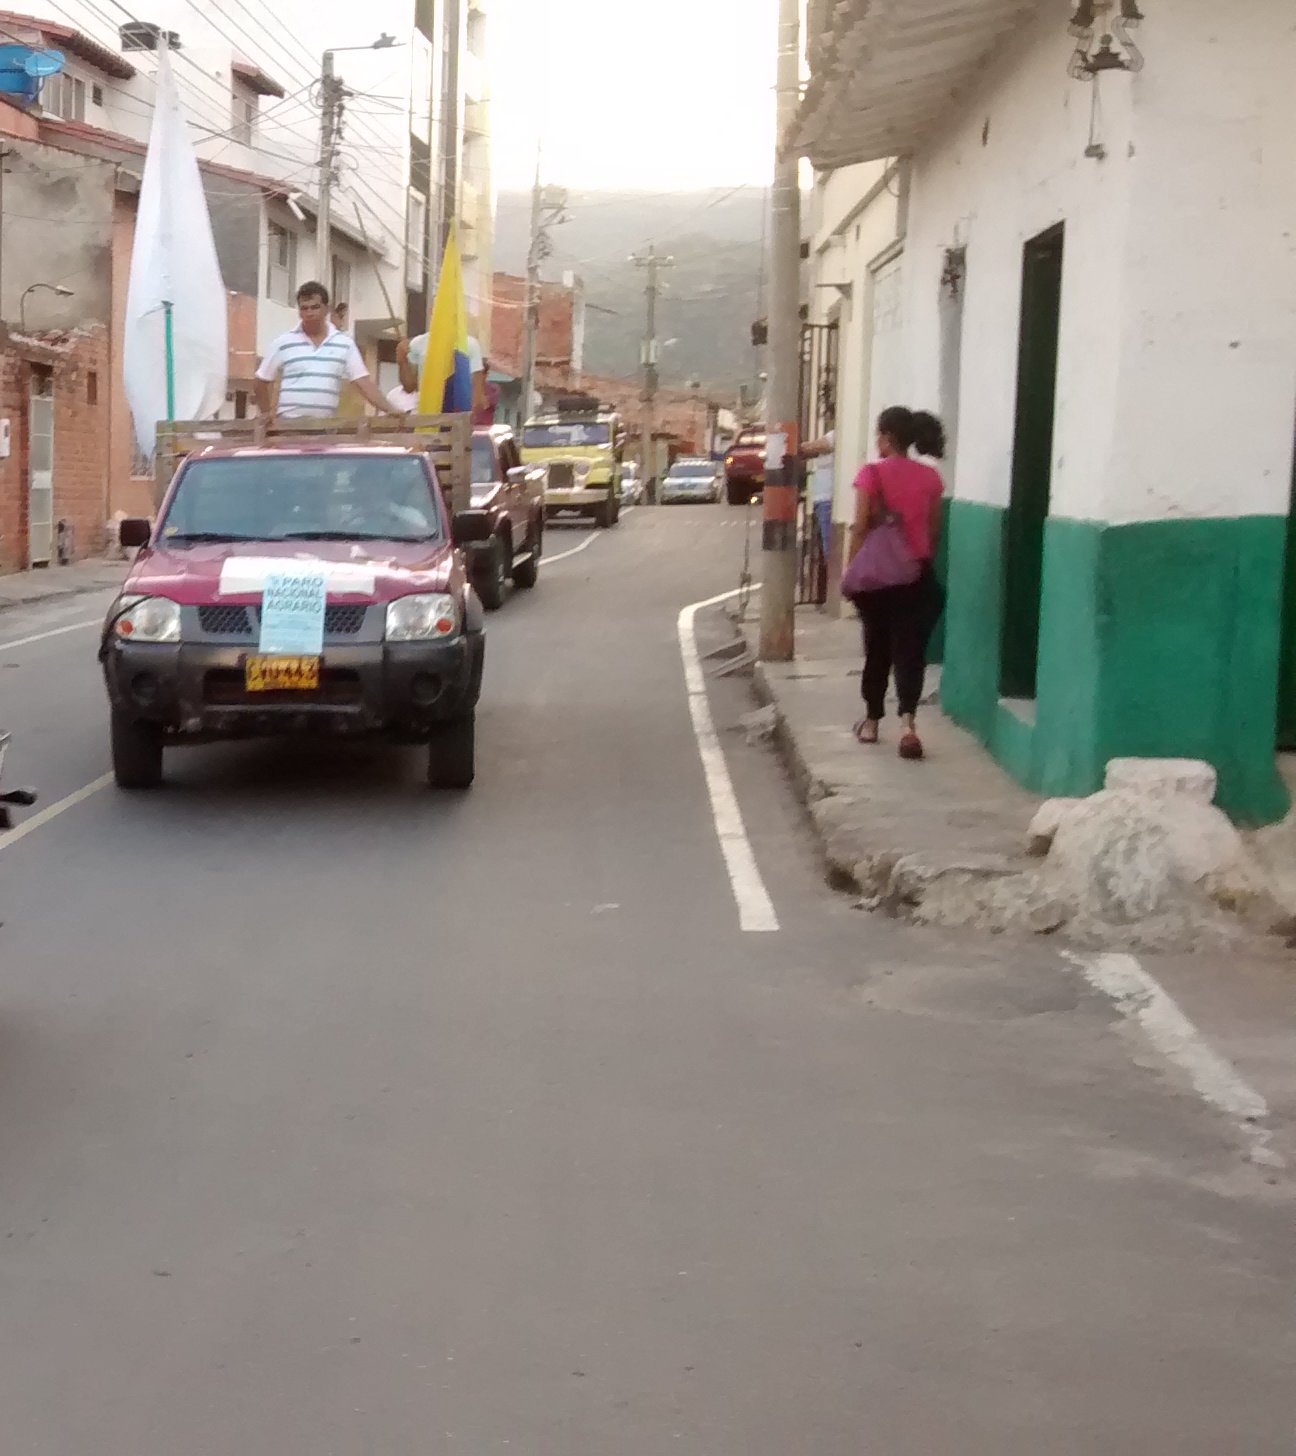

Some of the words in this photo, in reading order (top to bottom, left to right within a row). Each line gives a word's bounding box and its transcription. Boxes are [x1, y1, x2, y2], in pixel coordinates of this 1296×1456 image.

[282, 577, 324, 587] PARO
[267, 587, 323, 599] NACIONAL
[266, 599, 322, 614] AGRARIO
